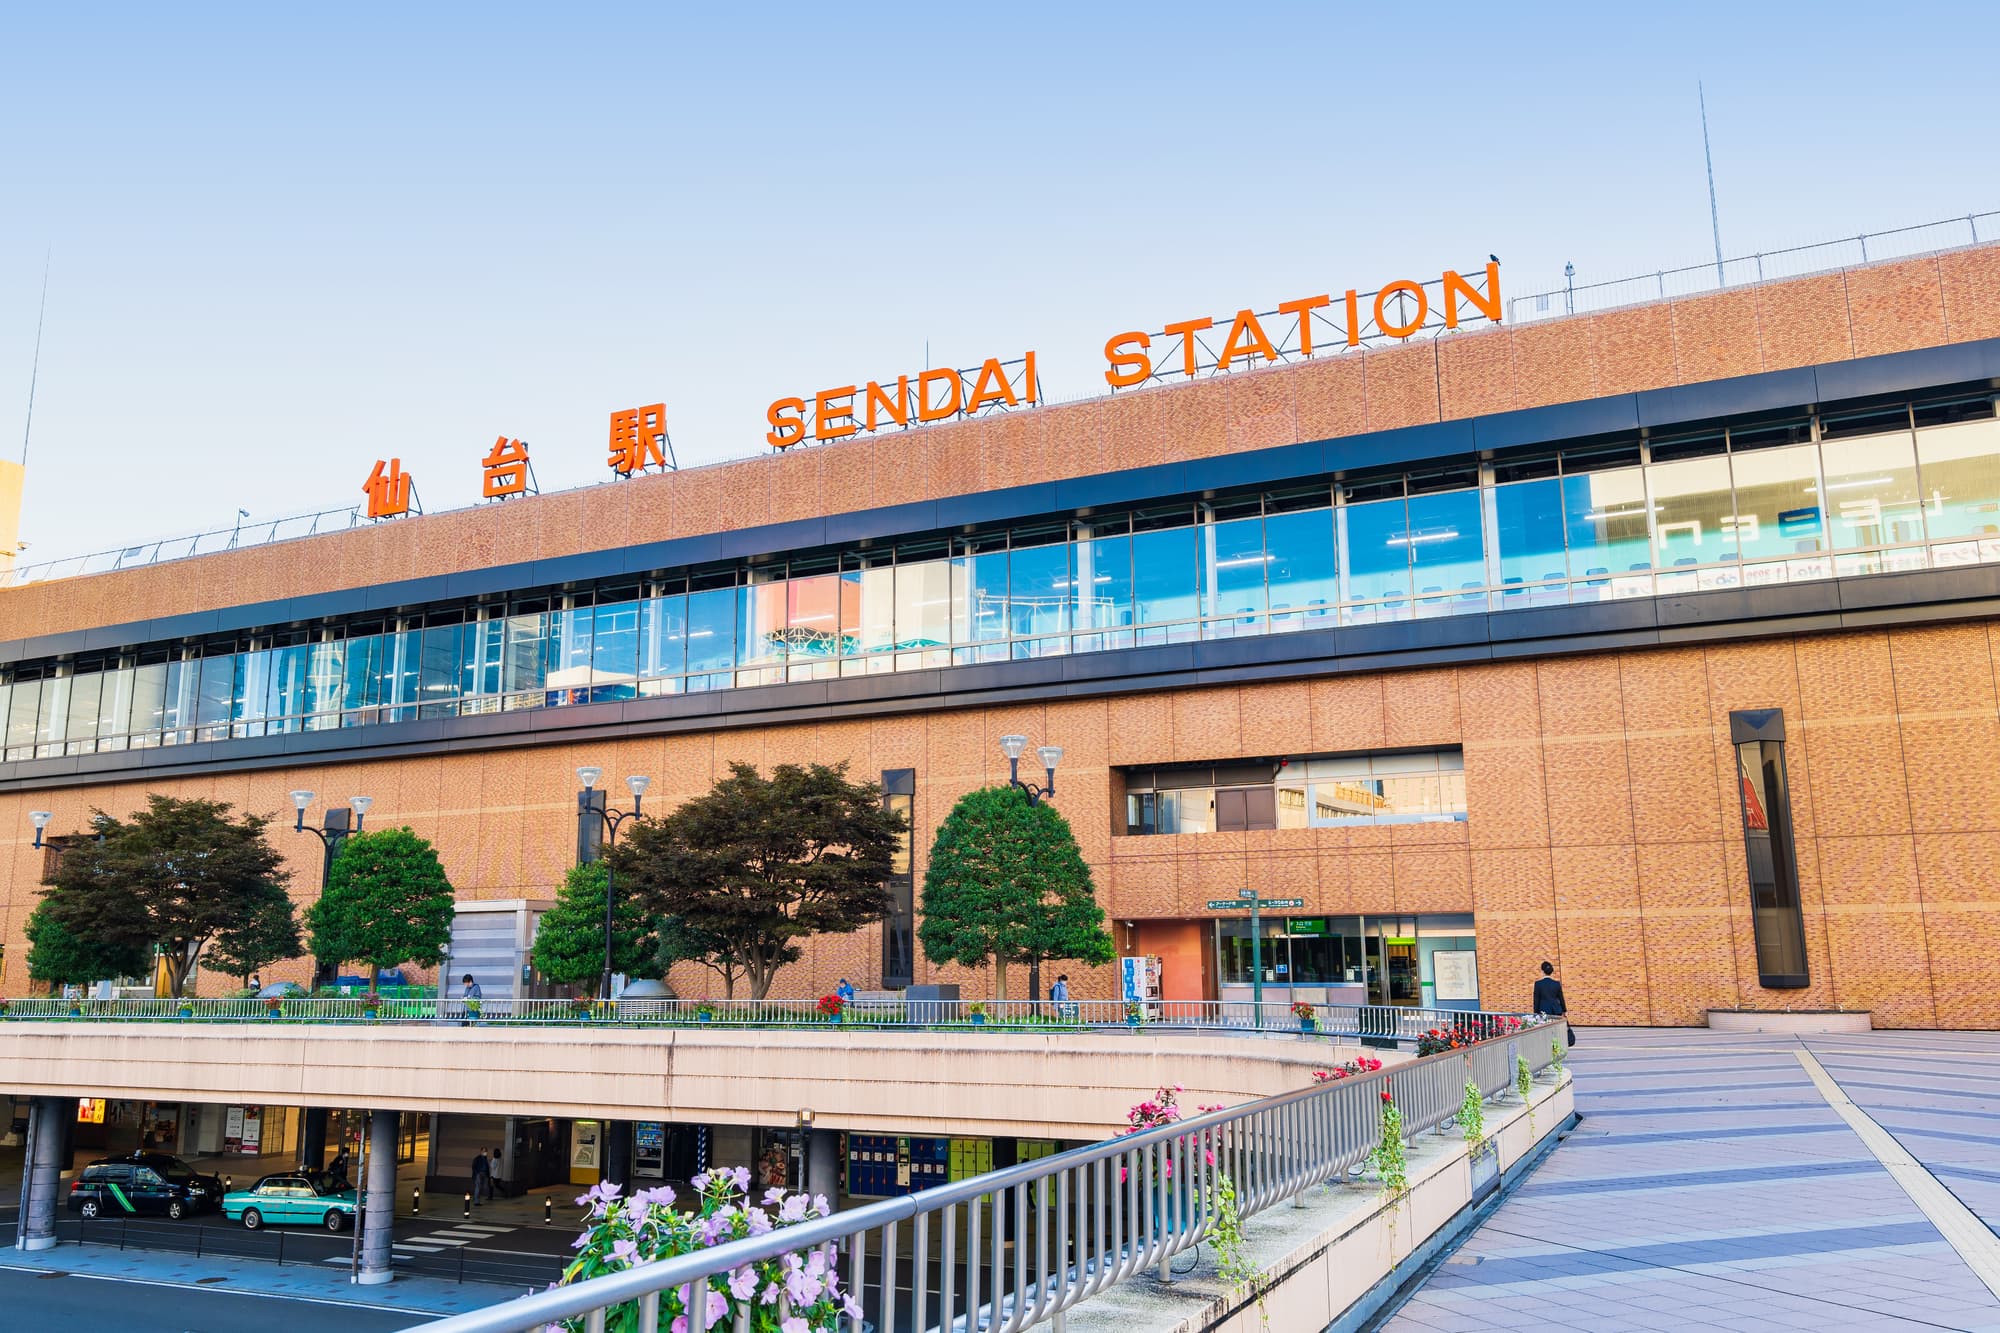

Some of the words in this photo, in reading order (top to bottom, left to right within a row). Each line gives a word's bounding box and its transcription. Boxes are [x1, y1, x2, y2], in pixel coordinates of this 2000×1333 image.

[767, 350, 1037, 448] SENDAI
[1105, 262, 1502, 387] STATION
[362, 403, 667, 519] 仙台駅
